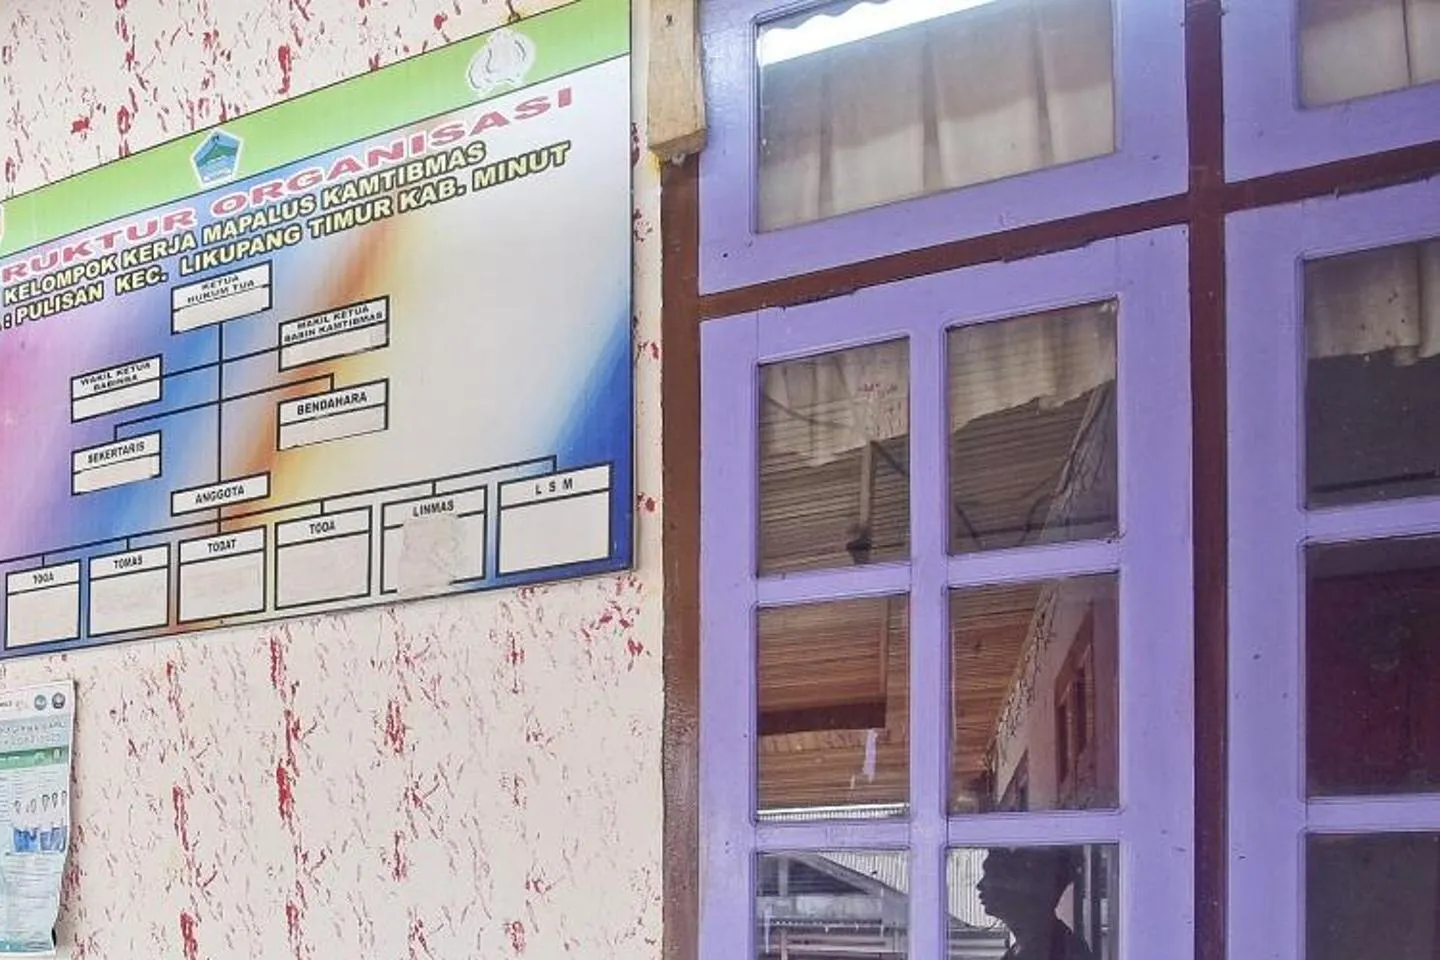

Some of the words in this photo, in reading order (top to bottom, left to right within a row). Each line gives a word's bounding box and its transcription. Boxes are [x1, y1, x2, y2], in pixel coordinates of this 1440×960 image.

[211, 87, 573, 217] ORGANISASI
[4, 254, 117, 307] KELOMPOK
[121, 230, 197, 268] KERJA
[201, 193, 316, 249] MAPALUS
[323, 139, 487, 211] KAMTIBMAS
[15, 280, 105, 326] PULISAN
[114, 264, 168, 297] KEC.
[180, 219, 302, 278] LIKUPANG
[308, 197, 394, 239] TIMUR
[397, 179, 466, 215] KAB.
[471, 140, 572, 190] MINUT
[201, 275, 239, 290] KETUA
[297, 391, 367, 415] BENDAHARA
[87, 441, 145, 464] SEKERTARIS
[195, 485, 245, 504] ANGGOTA
[413, 500, 455, 517] LINMAS
